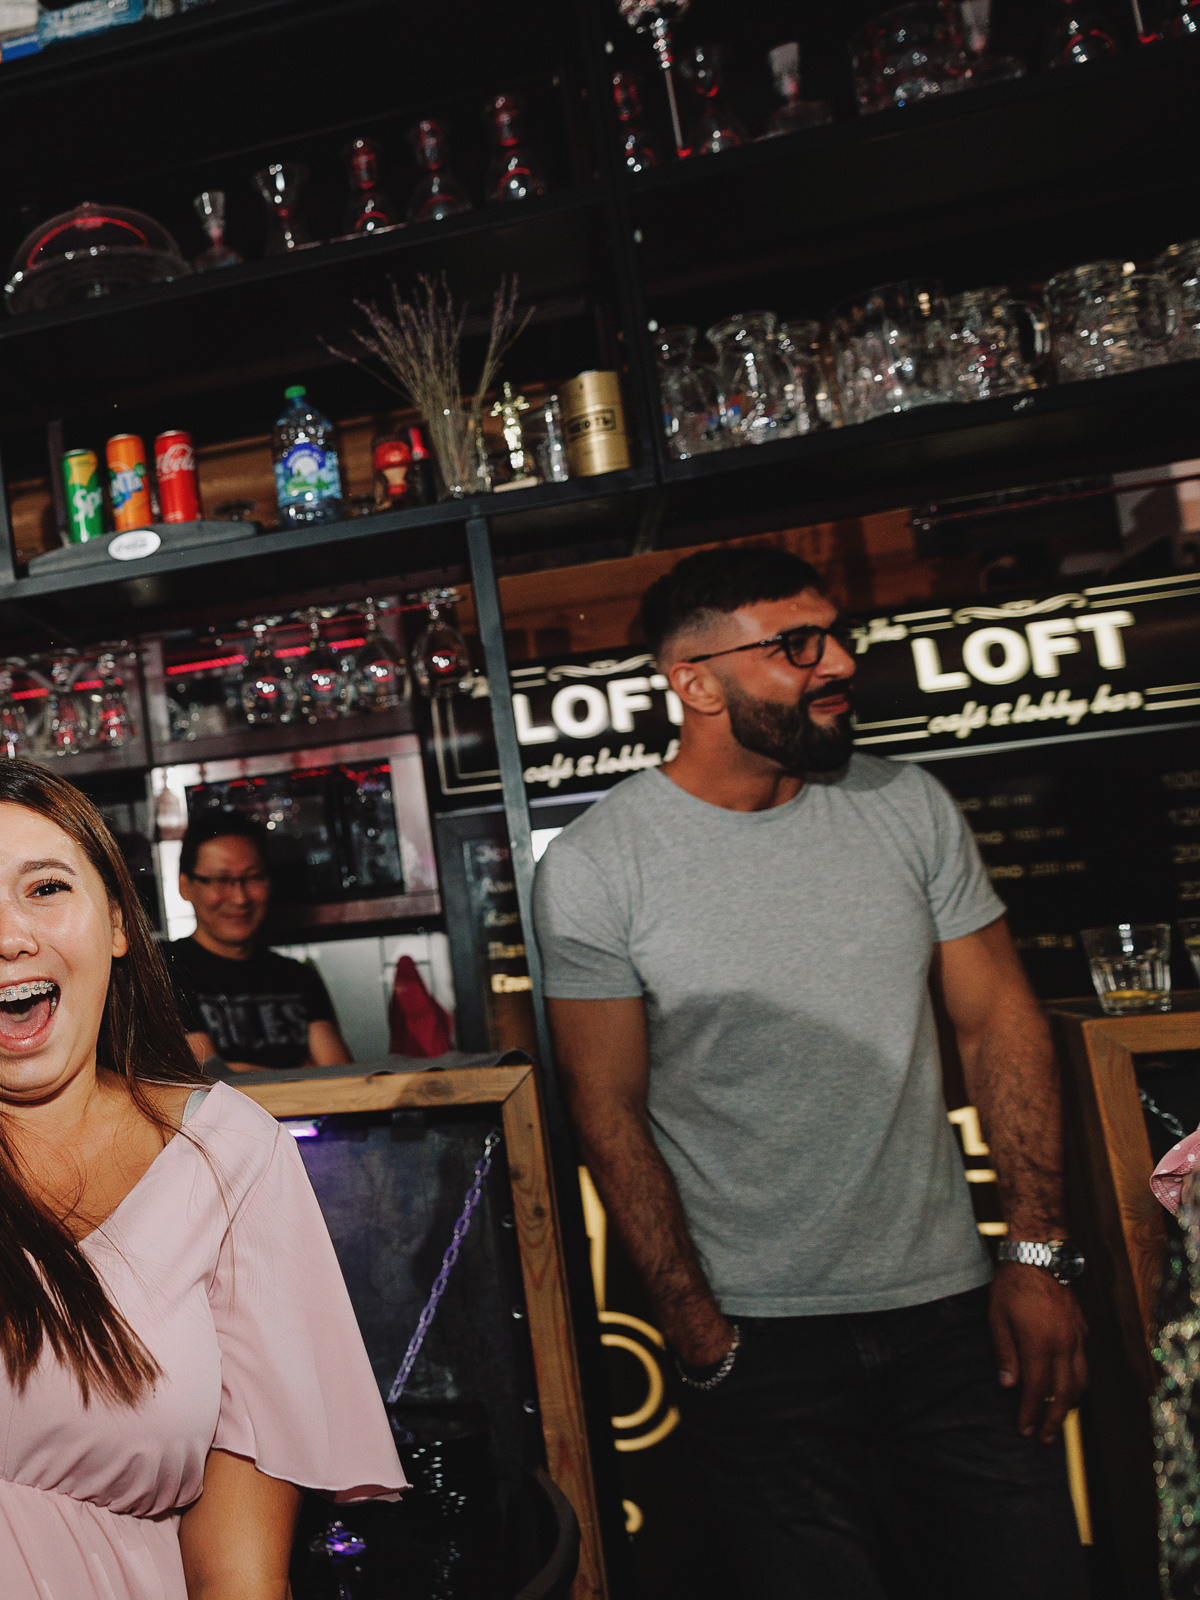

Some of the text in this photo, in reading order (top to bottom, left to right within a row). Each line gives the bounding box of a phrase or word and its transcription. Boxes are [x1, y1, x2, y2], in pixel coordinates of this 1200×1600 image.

[910, 609, 1135, 693] LOFT
[1012, 689, 1089, 726] lobby
[1090, 684, 1144, 714] bar
